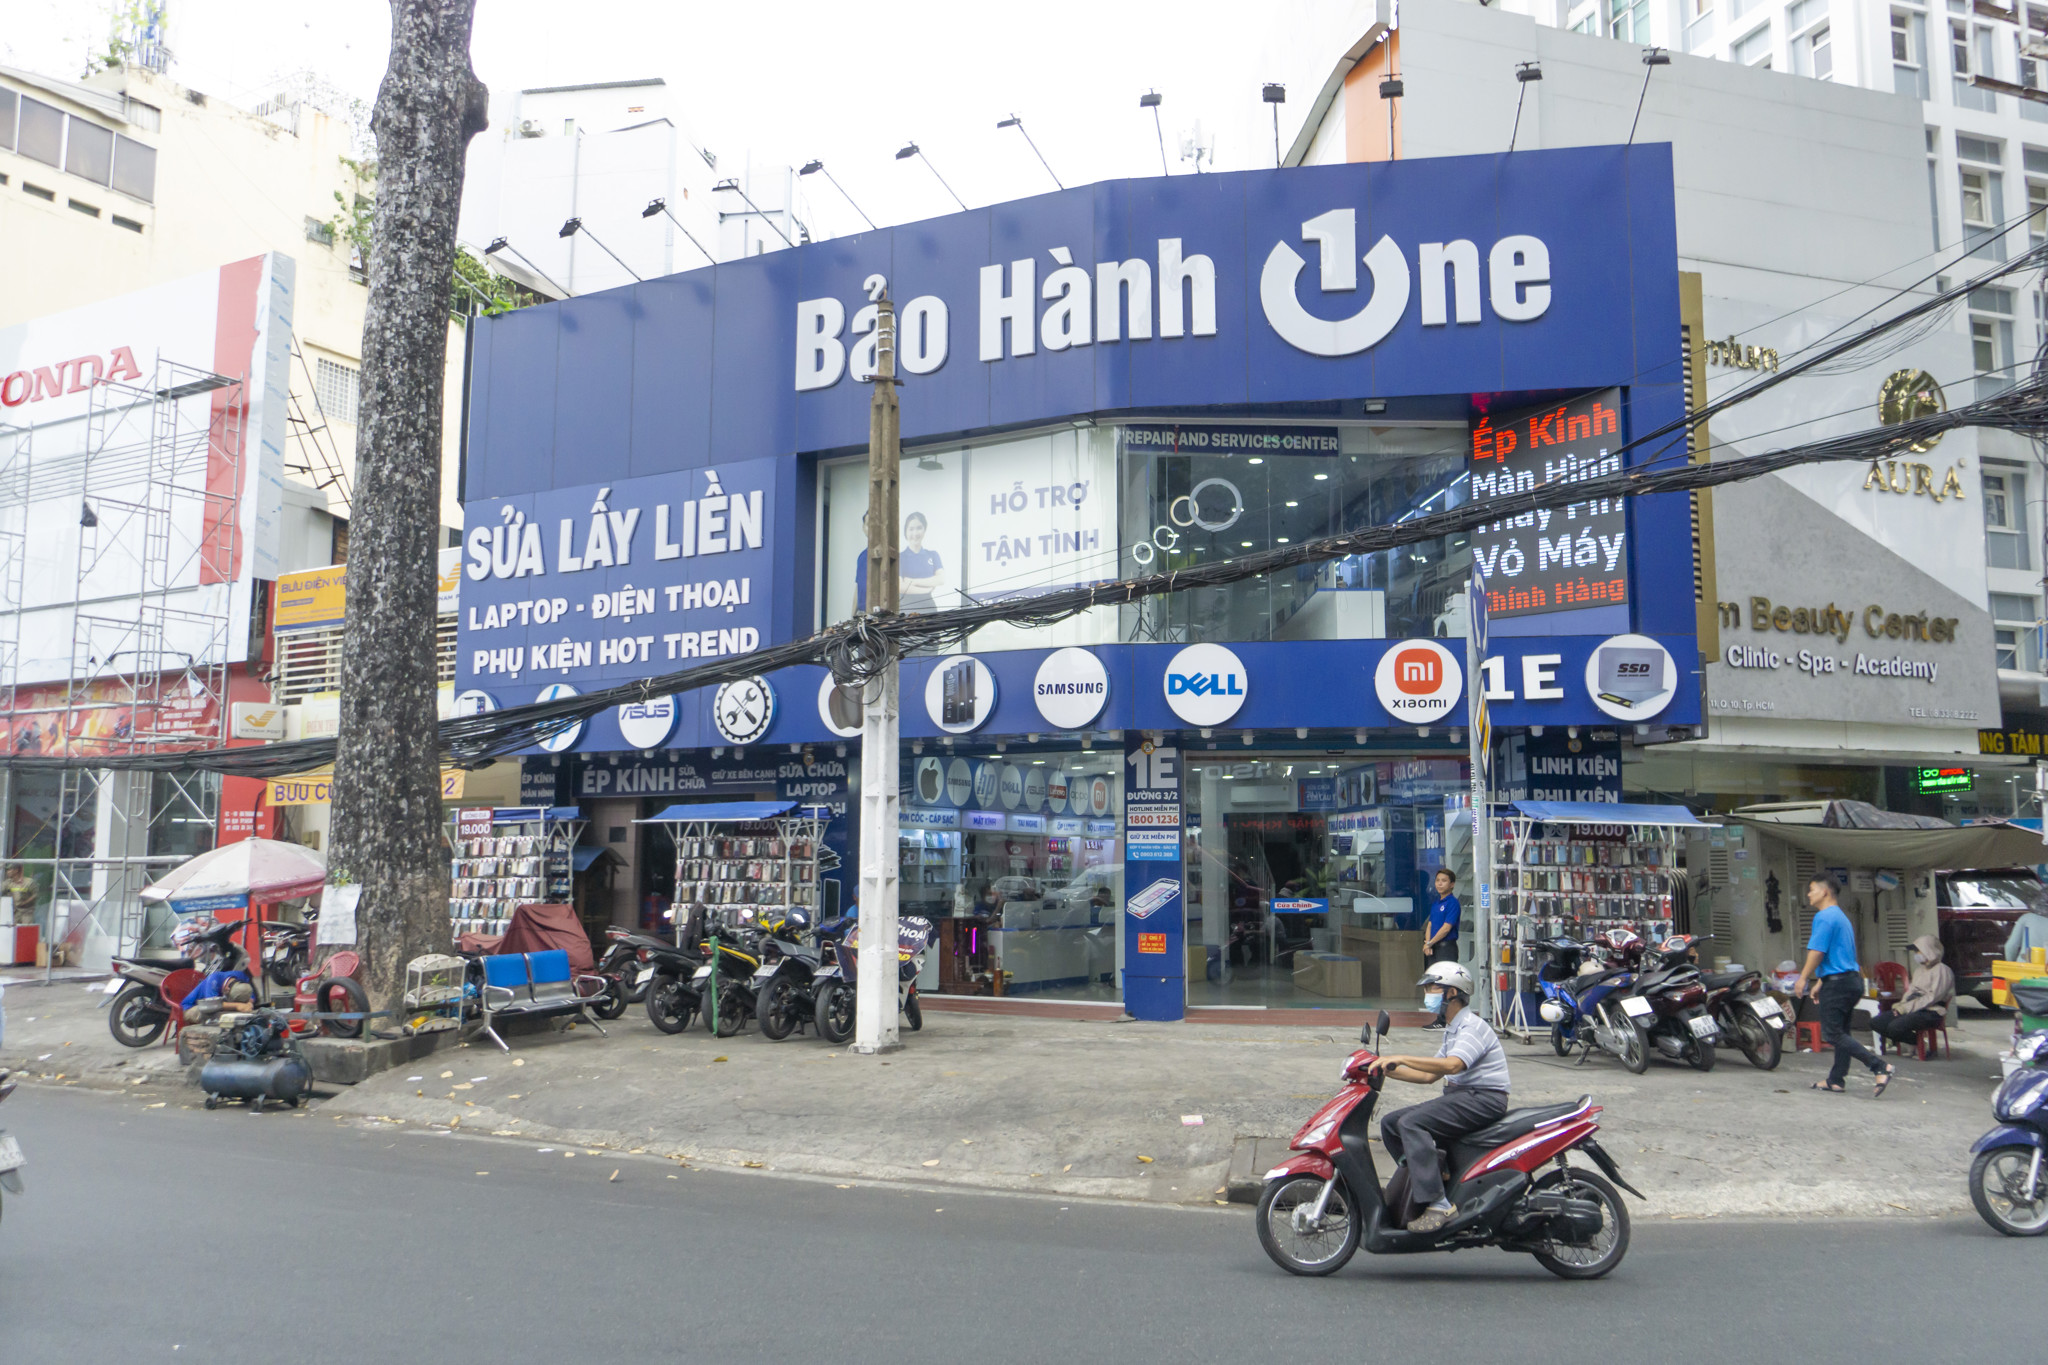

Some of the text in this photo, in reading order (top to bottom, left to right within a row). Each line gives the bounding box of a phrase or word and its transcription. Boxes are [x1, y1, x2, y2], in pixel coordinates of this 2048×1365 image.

[795, 273, 949, 391] Bảo
[979, 237, 1217, 363] Hành
[0, 346, 143, 407] ONDA
[1125, 429, 1339, 452] REPAIR AND SERVICES CENTER
[1473, 403, 1617, 463] Ép Kính
[1472, 466, 1535, 499] Màn
[1863, 459, 1966, 502] AURA
[990, 480, 1091, 515] HỖ TRỢ
[466, 470, 764, 581] SỬA LẤY LIỀN
[982, 529, 1099, 567] TẬN TÌNH
[1473, 527, 1625, 578] Vỏ Máy
[281, 576, 302, 593] BƯU
[305, 574, 330, 592] ĐIỆN
[469, 597, 568, 631] LAPTOP
[592, 583, 655, 623] ĐIỆN
[665, 577, 751, 613] THOẠI
[1751, 597, 1854, 643] Beauty
[1864, 604, 1959, 642] Center
[473, 627, 760, 679] PHỤ KIỆN HOT TREND
[1727, 645, 1780, 669] Clinic
[1799, 650, 1834, 677] Spa
[1855, 653, 1939, 682] Academy
[1481, 654, 1564, 700] 1E
[1617, 663, 1651, 673] SSD
[1037, 682, 1104, 696] SAMSUNG
[1168, 672, 1244, 697] DELL
[621, 704, 670, 720] ASUS
[1392, 699, 1447, 709] xiaomi
[2009, 729, 2040, 754] TÂM
[534, 771, 555, 783] KÍNH
[582, 763, 675, 793] ÉP KÍNH
[727, 770, 737, 779] XE
[738, 768, 753, 778] BÊN
[754, 770, 776, 780] CẠNH
[779, 761, 845, 778] SỬA CHỮA
[1127, 747, 1178, 788] 1E
[1532, 755, 1617, 780] LINH KIỆN
[275, 782, 309, 801] BƯU
[678, 775, 706, 789] CHỮA
[786, 783, 836, 796] LAPTOP
[1127, 790, 1178, 801] ĐƯỜNG 3/2
[461, 823, 490, 835] 19.000
[1129, 815, 1153, 825] 1800
[1156, 814, 1178, 824] 1236
